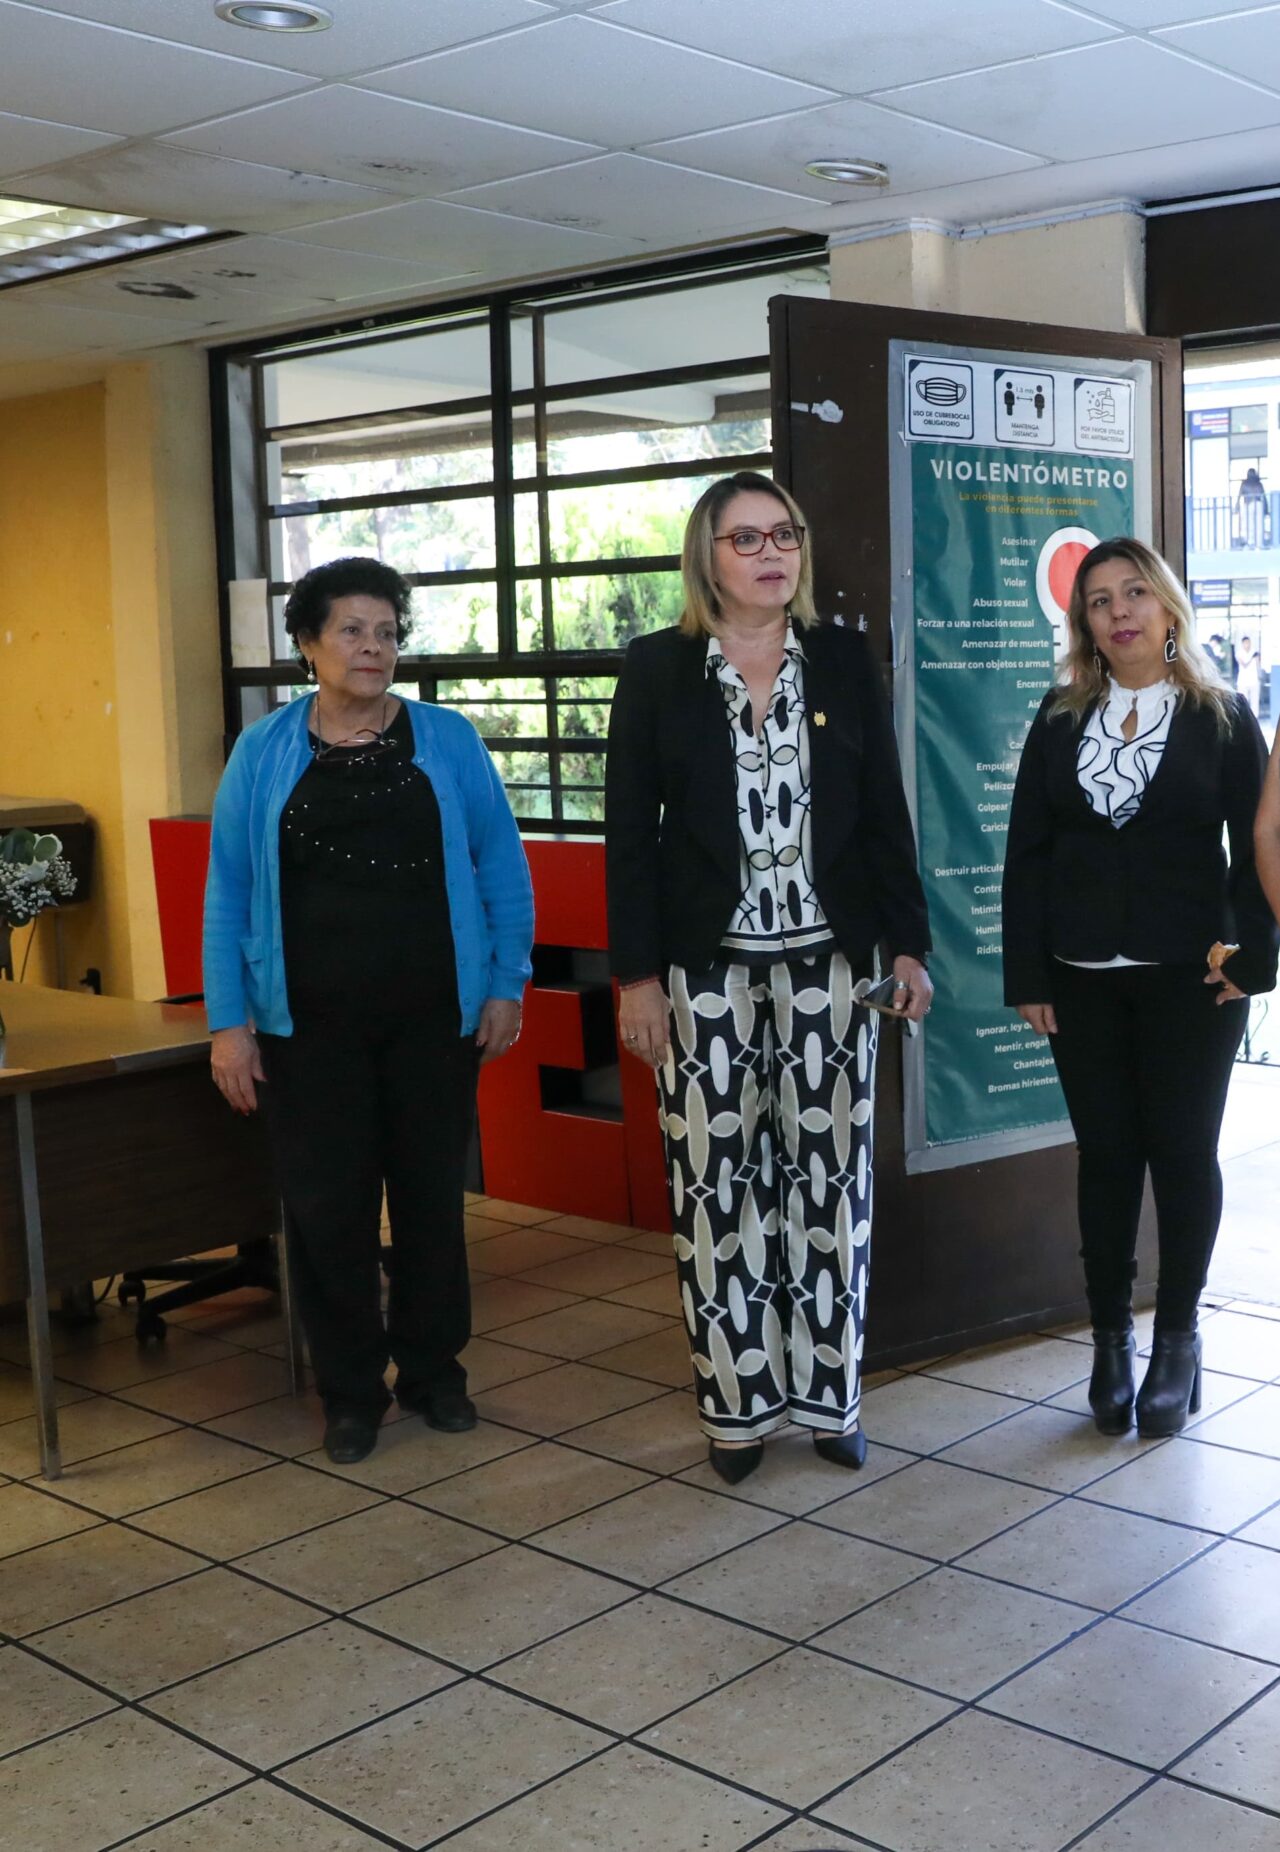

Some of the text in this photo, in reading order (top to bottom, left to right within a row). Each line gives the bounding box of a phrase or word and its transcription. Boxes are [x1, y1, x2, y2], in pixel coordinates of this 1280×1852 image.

[934, 411, 970, 420] CUBREBOCAS
[923, 418, 960, 427] OBLIGATORIO
[1011, 422, 1039, 430] MANTENGA
[1012, 430, 1038, 438] DISTANCIA
[930, 459, 1128, 489] VIOLENTÓMETRO
[959, 492, 970, 500] La
[973, 492, 1015, 502] violencia
[998, 504, 1044, 515] diferentes
[1046, 507, 1078, 517] formas
[1002, 537, 1036, 546] Asesinar
[1000, 557, 1029, 566] Mutilar
[1003, 578, 1026, 587] Violar
[973, 598, 1028, 608] Abuso sexual
[917, 618, 945, 628] Forzar
[954, 620, 971, 628] una
[972, 618, 1009, 628] relación
[1009, 619, 1034, 628] sexual
[961, 639, 1049, 648] Amenazar de muerte
[921, 660, 966, 669] Amenazar
[968, 661, 984, 669] con
[986, 660, 1017, 671] objetos
[1024, 661, 1049, 669] armas
[1016, 680, 1050, 689] Encerrar
[984, 781, 1016, 791] Pellizca
[981, 821, 1009, 832] Caricia
[935, 865, 969, 877] Destruir
[971, 904, 1002, 915] Intimid
[976, 944, 1003, 955] Ridicu
[976, 1025, 1009, 1038] Ignorar,
[1010, 1022, 1022, 1032] ley
[994, 1041, 1024, 1053] Mentir,
[1013, 1057, 1055, 1070] Chantajea
[988, 1076, 1058, 1093] Bromas hirientes
